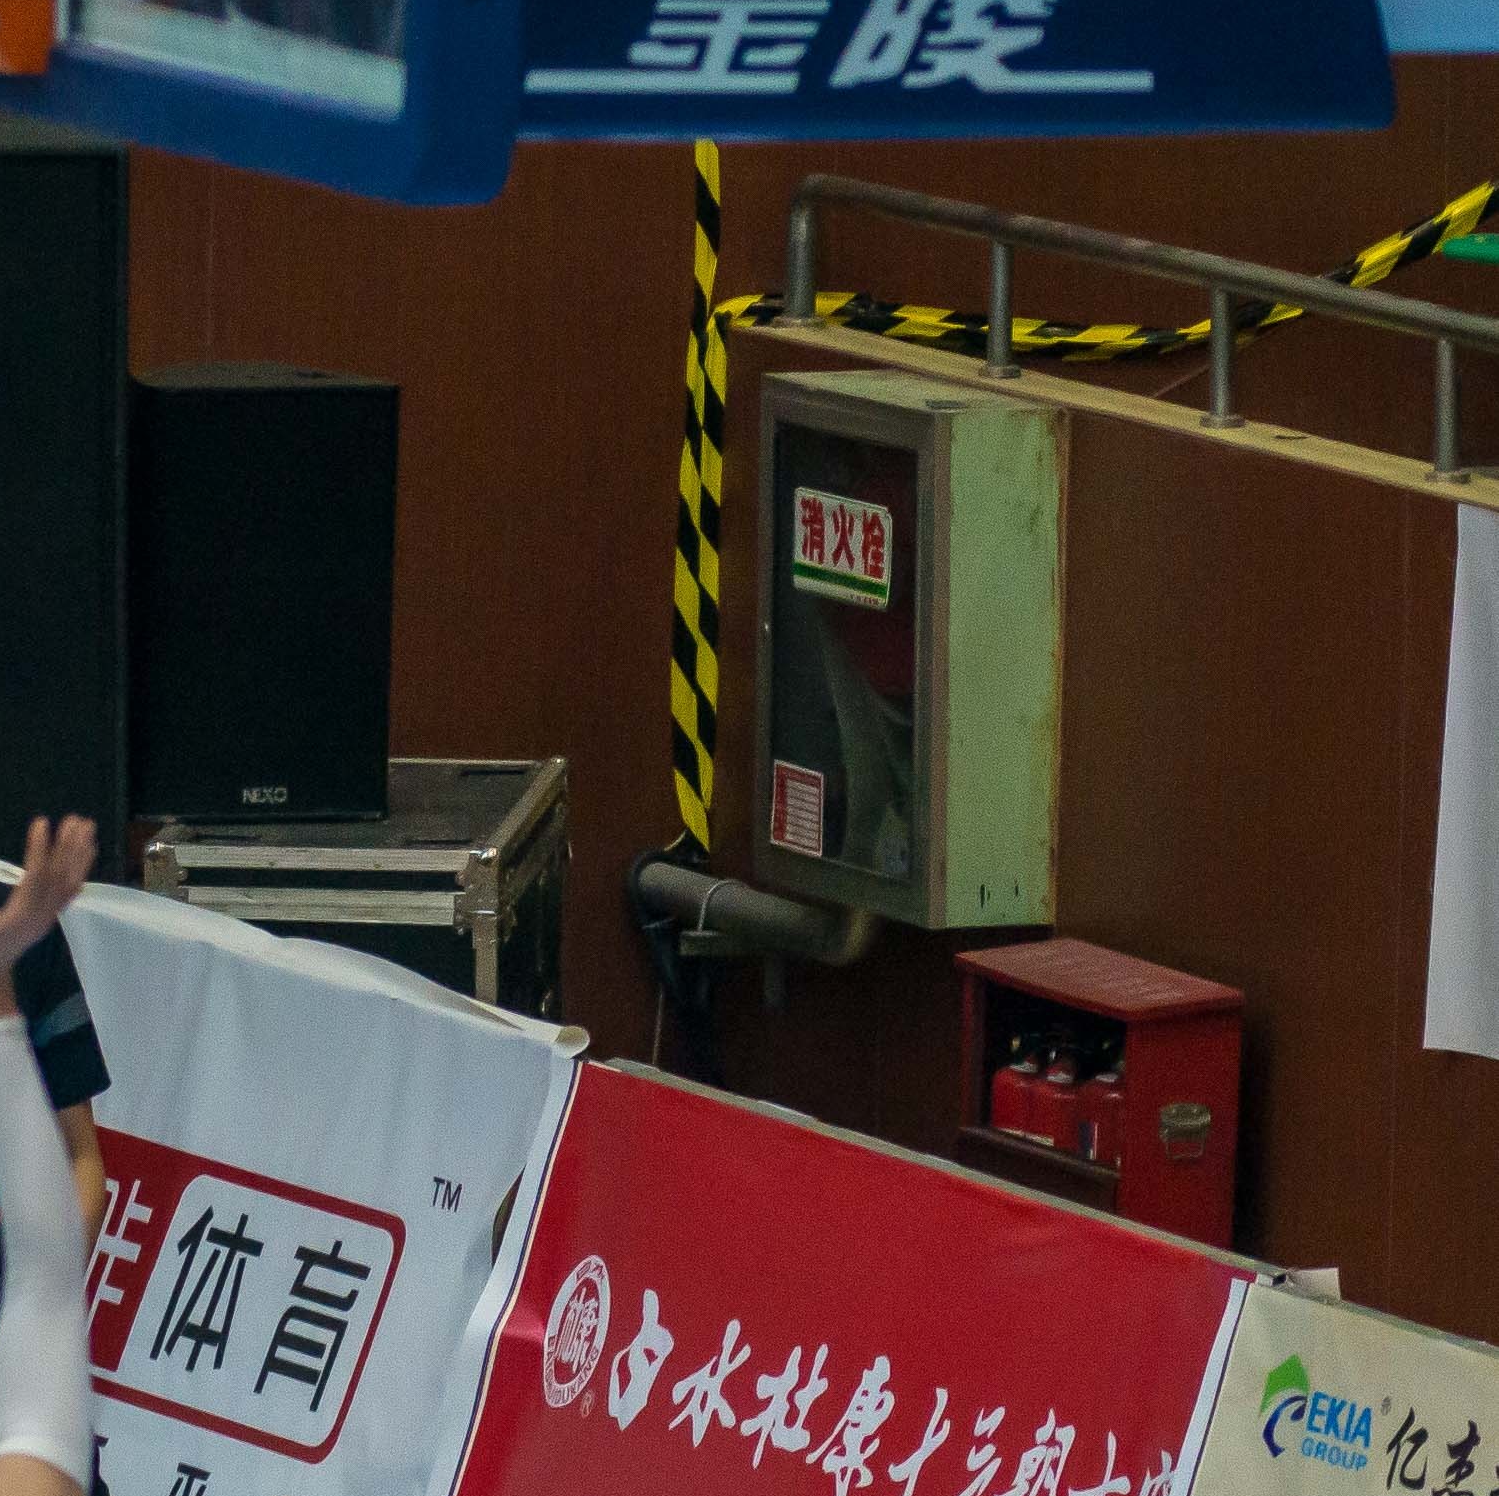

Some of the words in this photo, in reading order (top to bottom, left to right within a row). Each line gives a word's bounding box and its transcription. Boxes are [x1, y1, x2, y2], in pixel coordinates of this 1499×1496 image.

[800, 497, 886, 580] 消火栓
[432, 1176, 463, 1214] TM
[1300, 1437, 1369, 1472] GROUP
